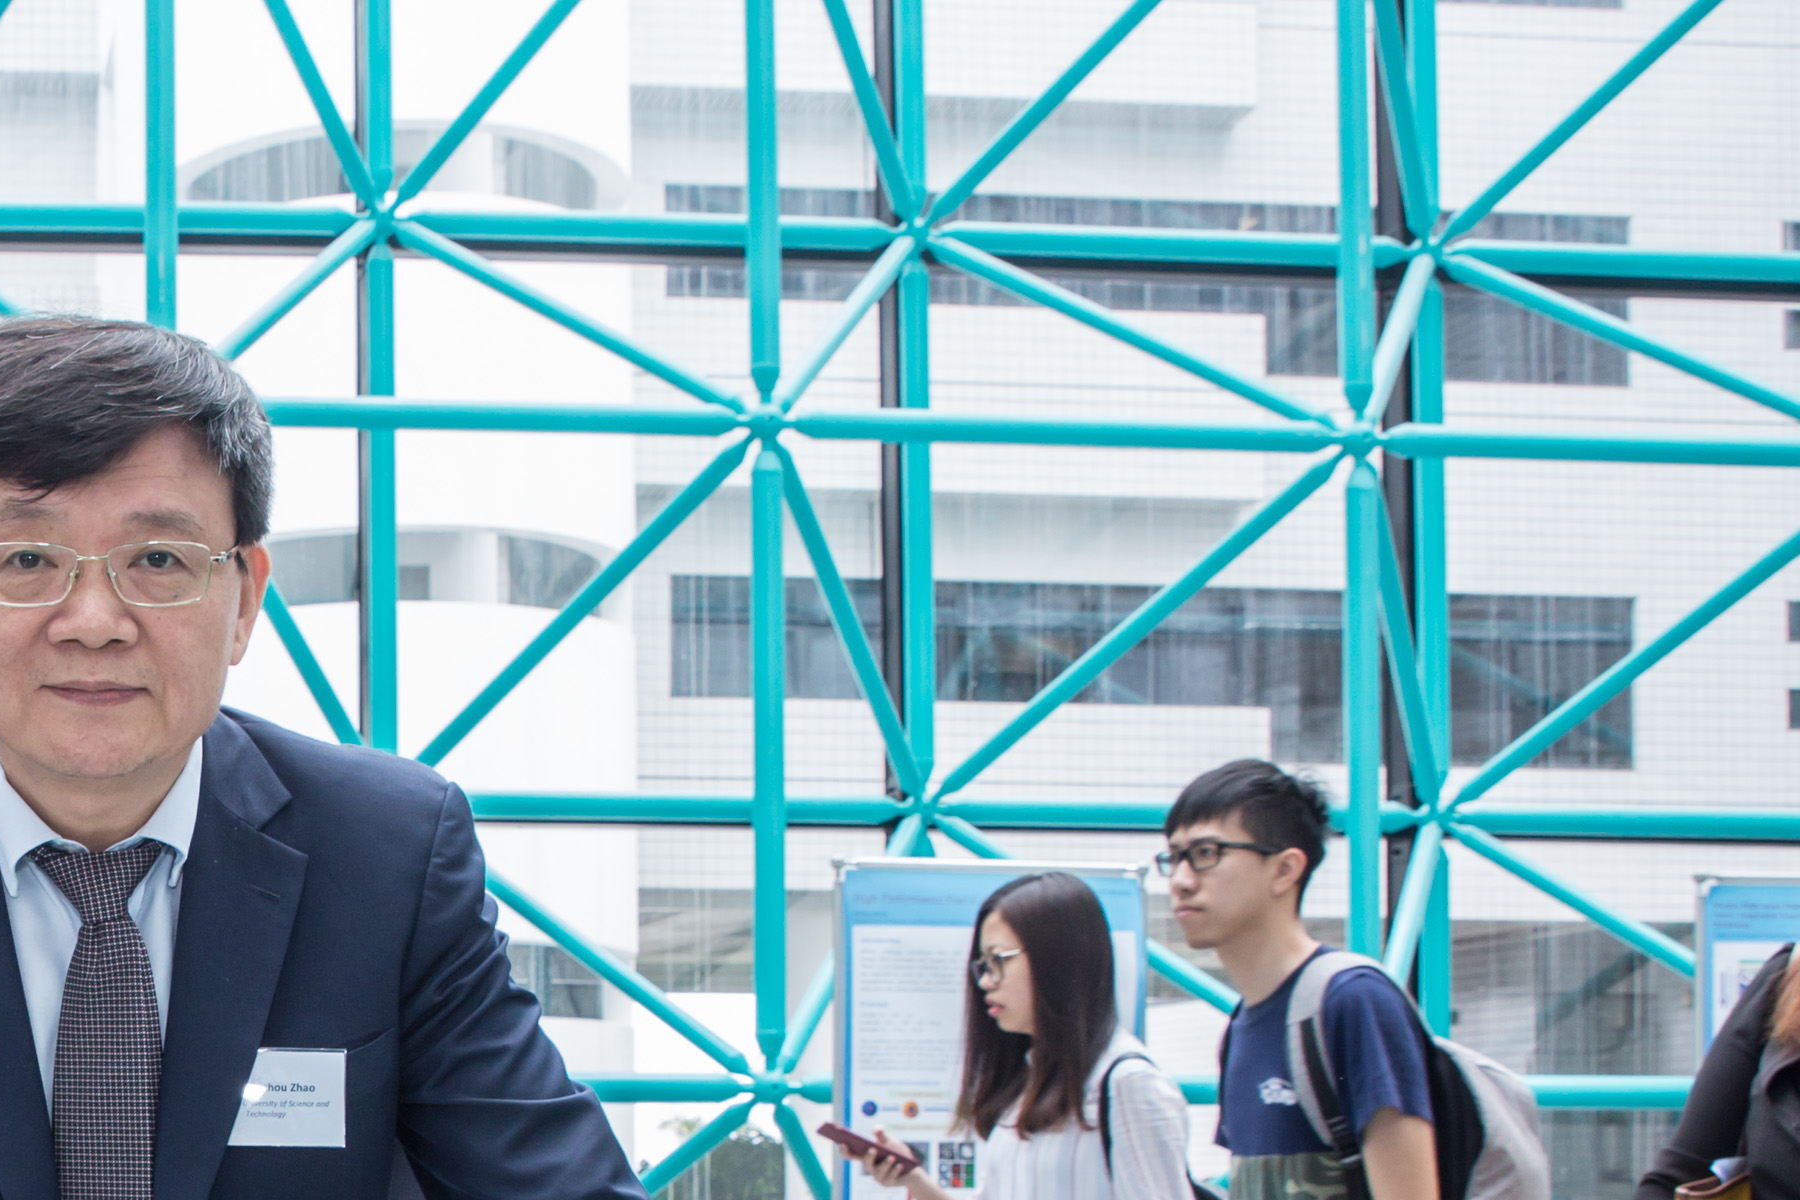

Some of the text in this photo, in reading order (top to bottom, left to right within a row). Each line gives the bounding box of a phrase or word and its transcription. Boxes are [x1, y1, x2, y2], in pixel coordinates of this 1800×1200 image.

[290, 1083, 316, 1092] Zhao
[279, 1100, 288, 1109] of
[288, 1100, 315, 1108] Science
[315, 1100, 331, 1108] and
[246, 1110, 287, 1119] Technology
